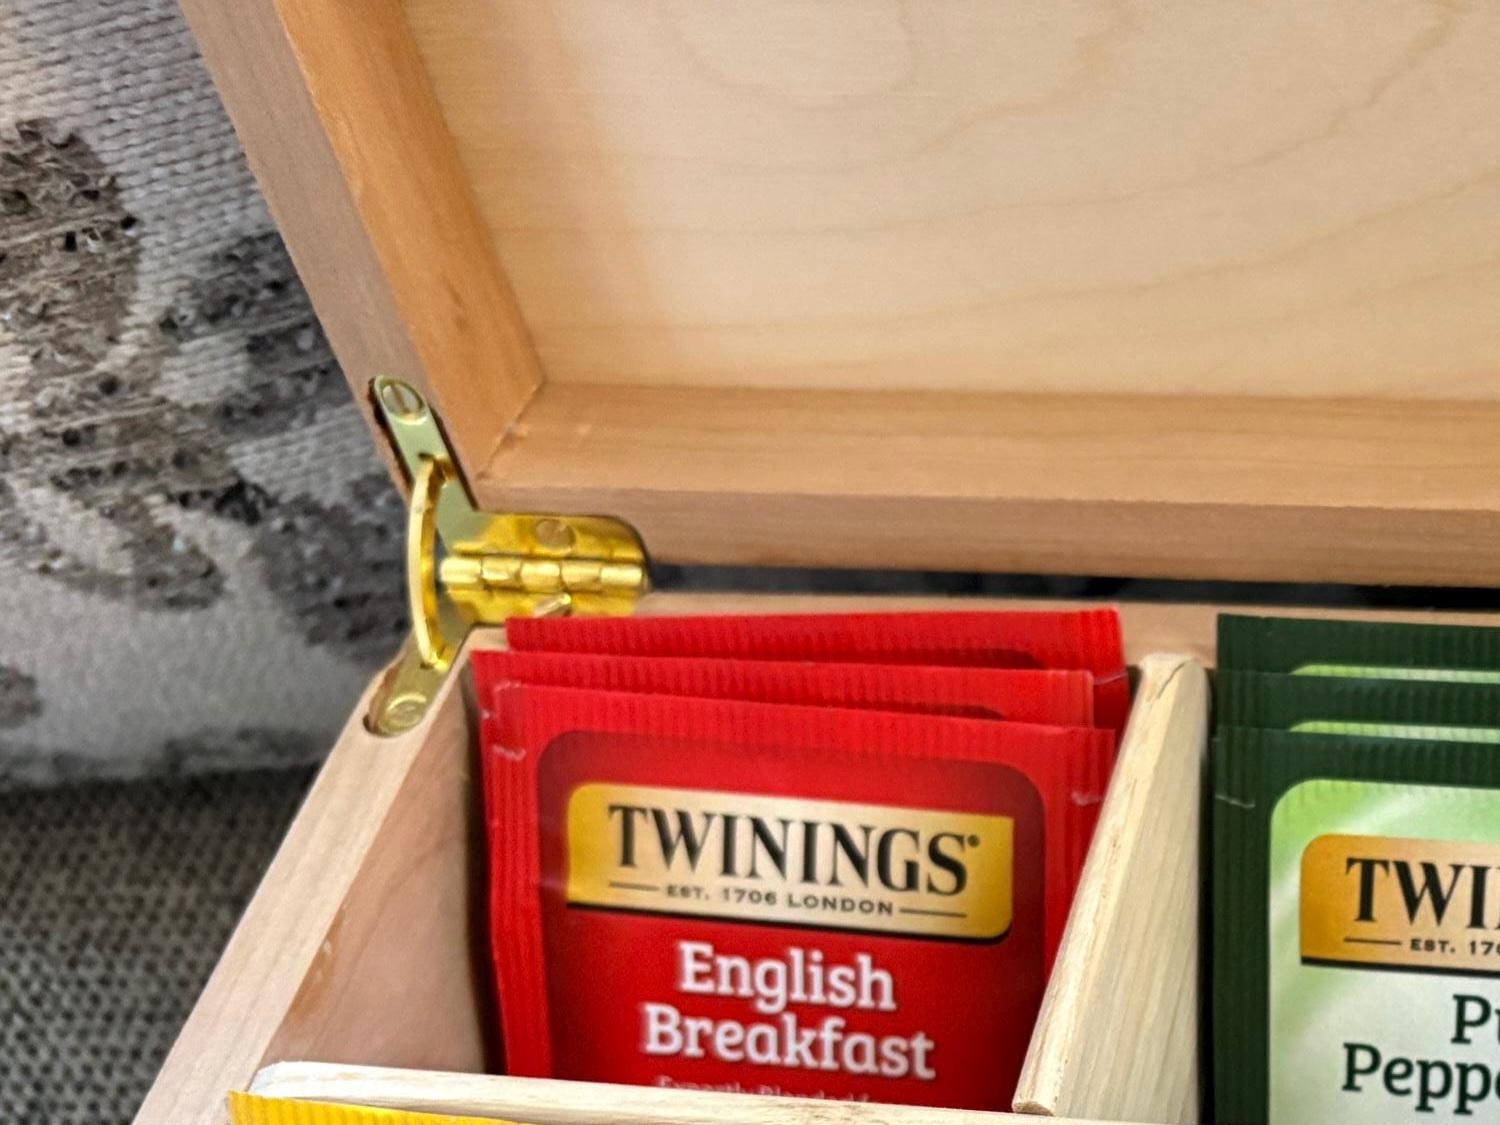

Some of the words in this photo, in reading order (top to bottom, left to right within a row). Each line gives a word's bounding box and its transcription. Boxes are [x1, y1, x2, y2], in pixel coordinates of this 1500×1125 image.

[666, 884, 710, 902] EST.
[722, 888, 777, 906] 1706
[787, 892, 894, 916] LONDON
[1410, 938, 1456, 955] EST.
[680, 941, 896, 1012] English
[644, 1003, 936, 1081] Breakfast
